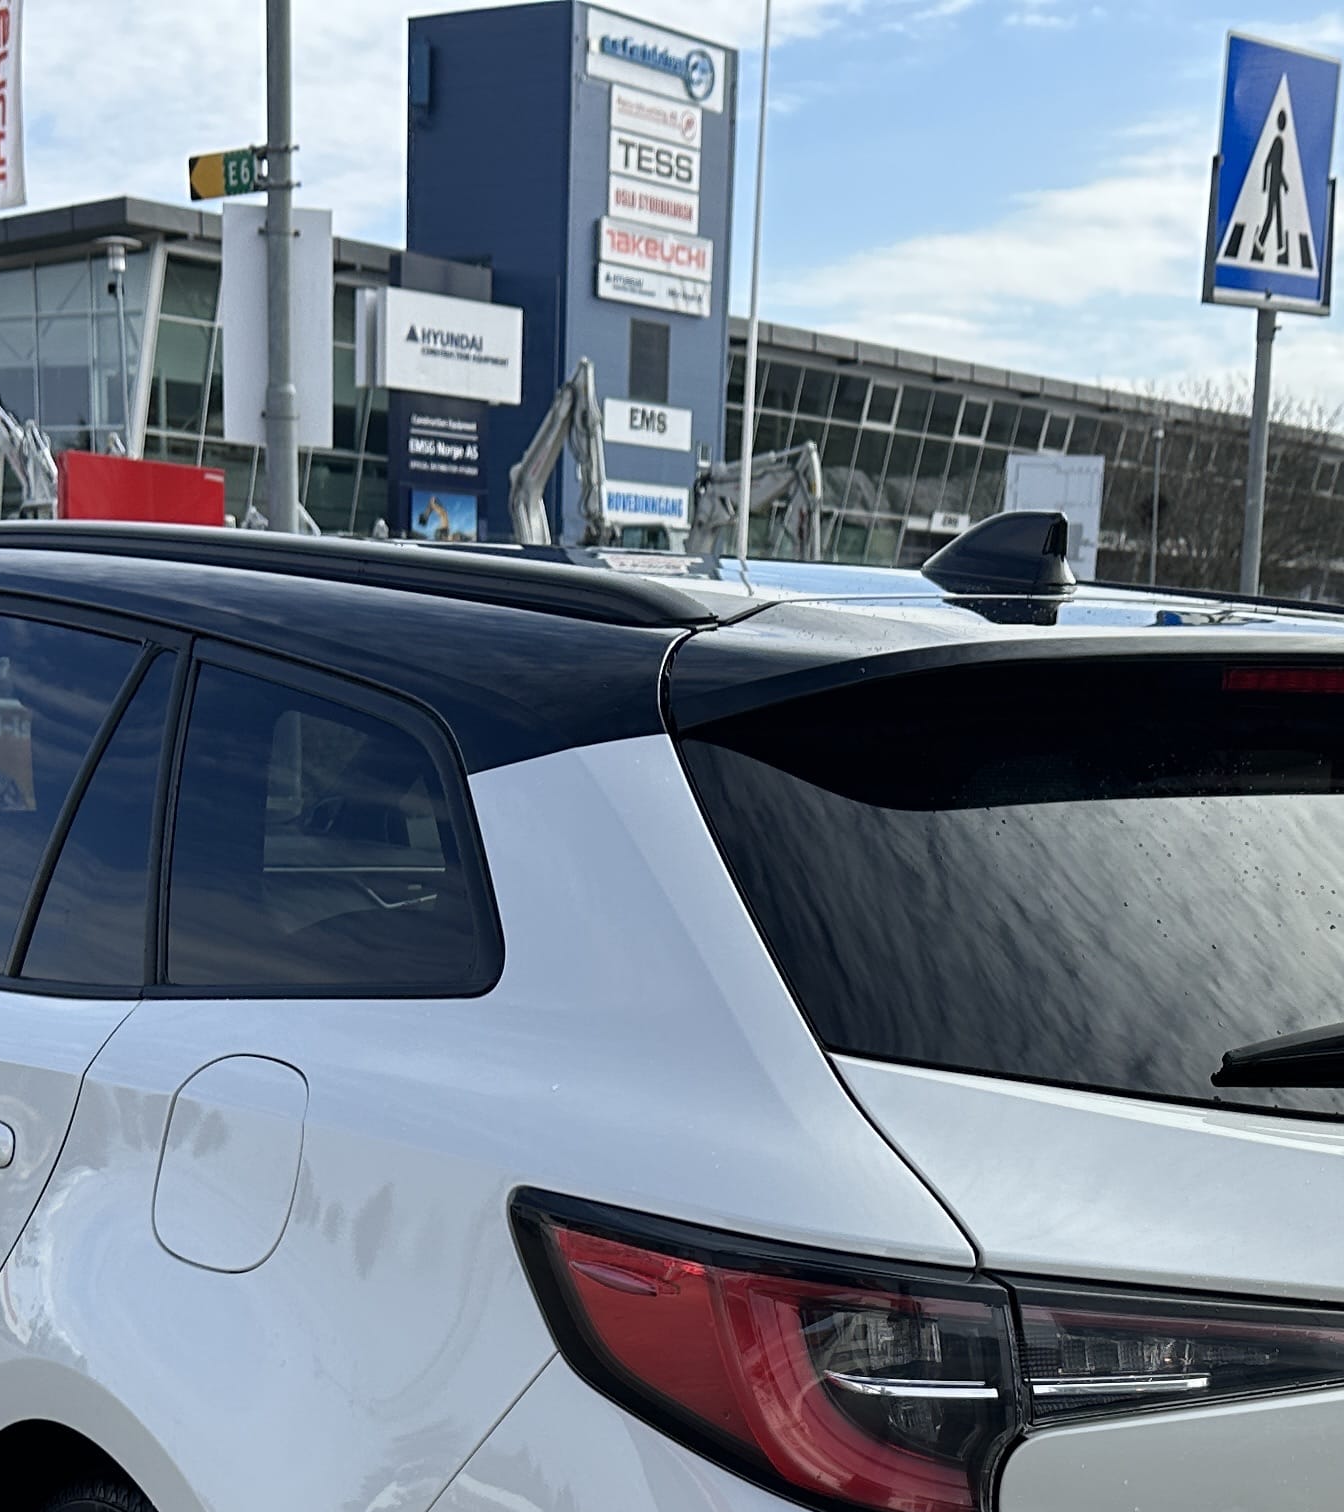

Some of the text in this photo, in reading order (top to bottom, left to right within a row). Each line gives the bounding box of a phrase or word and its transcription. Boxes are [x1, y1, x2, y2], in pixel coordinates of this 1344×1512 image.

[618, 137, 693, 183] TESS
[422, 327, 484, 352] HYUNDAI
[630, 407, 667, 433] EMS
